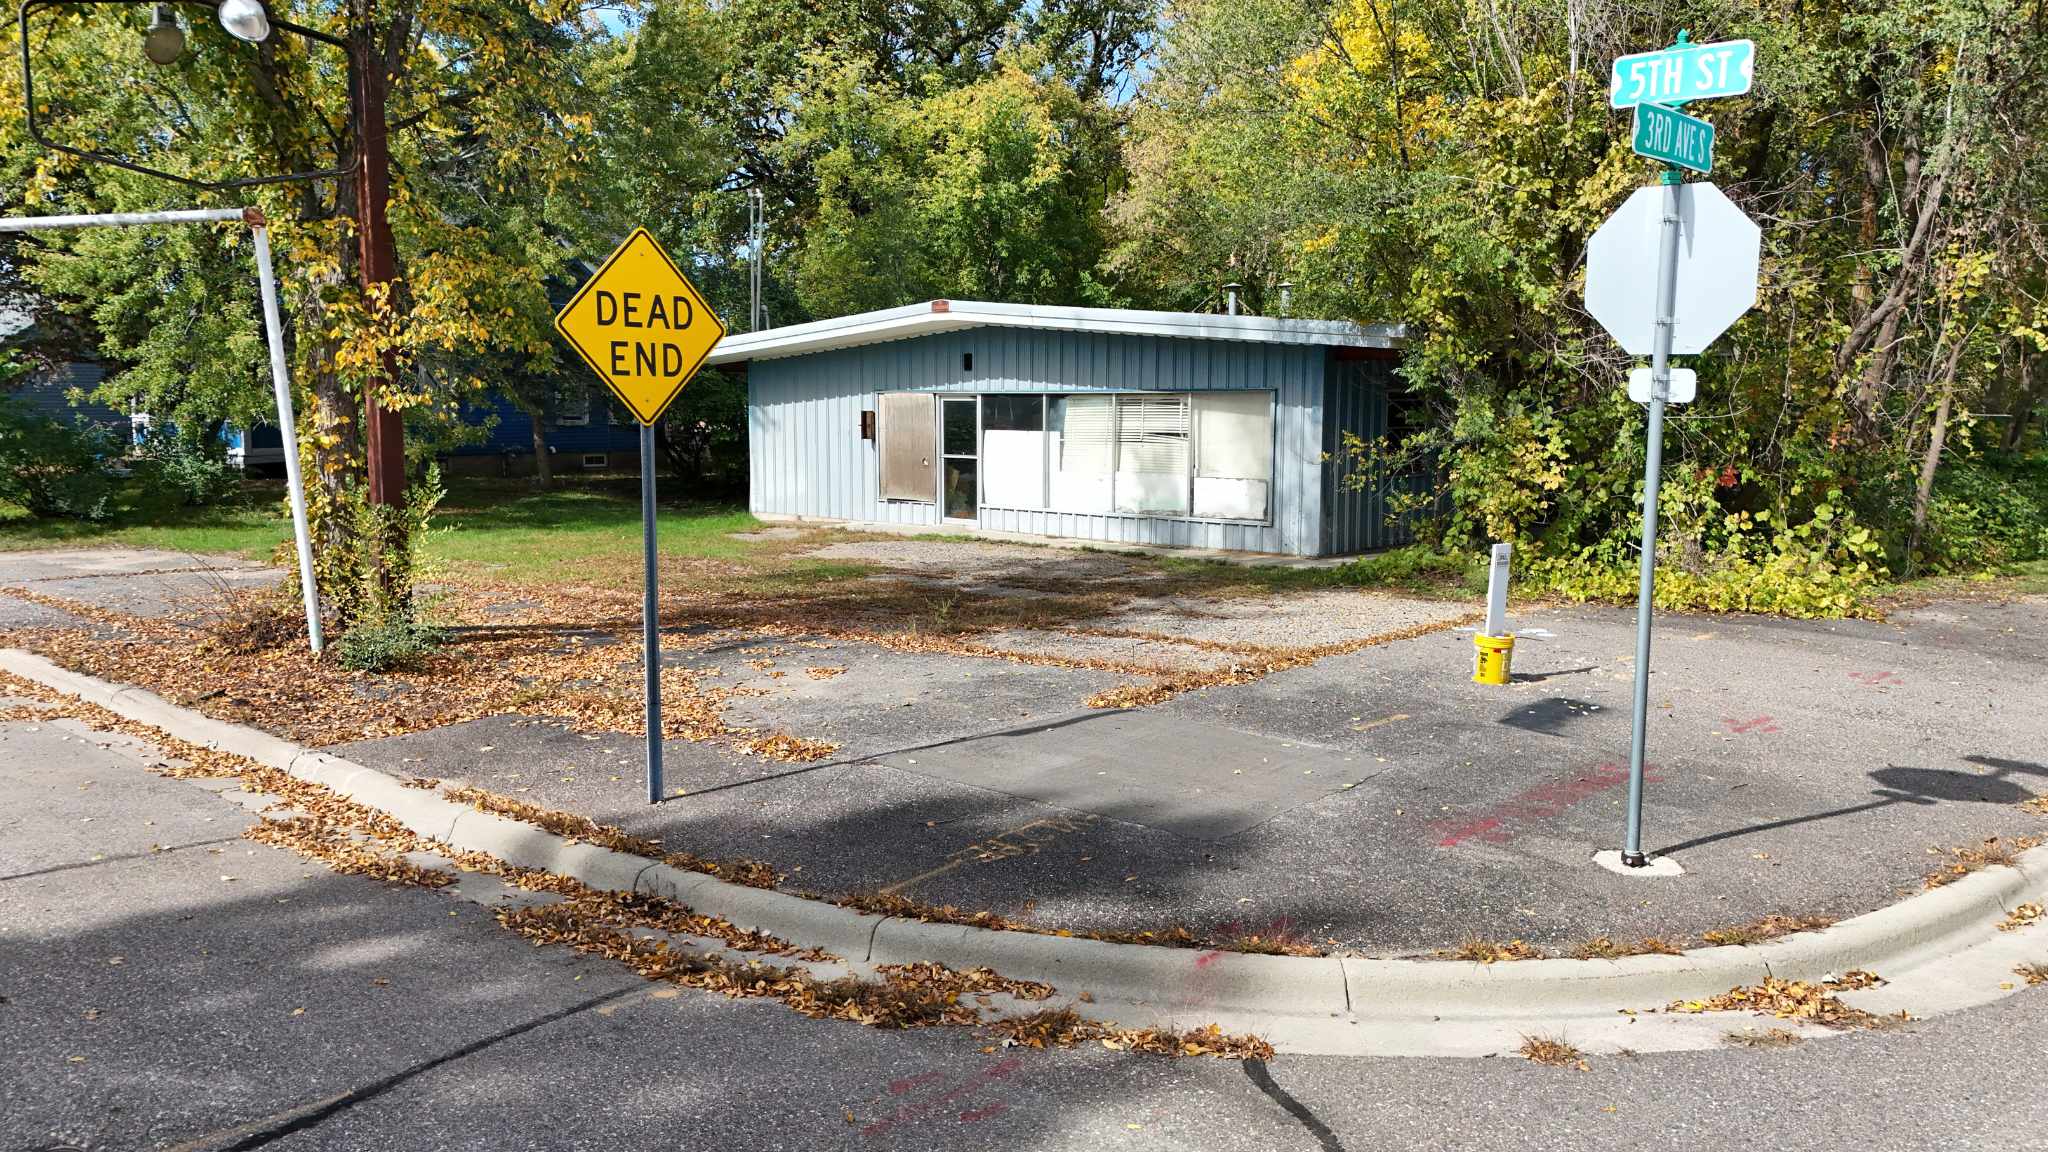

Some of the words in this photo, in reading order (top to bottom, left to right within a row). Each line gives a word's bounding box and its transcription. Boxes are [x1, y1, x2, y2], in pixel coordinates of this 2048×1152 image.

[1630, 58, 1683, 98] 5TH
[1696, 51, 1732, 90] ST
[1645, 112, 1672, 152] 3RD
[1675, 121, 1697, 161] AVE
[1698, 128, 1706, 164] S
[596, 290, 693, 330] DEAD
[610, 340, 683, 378] END
